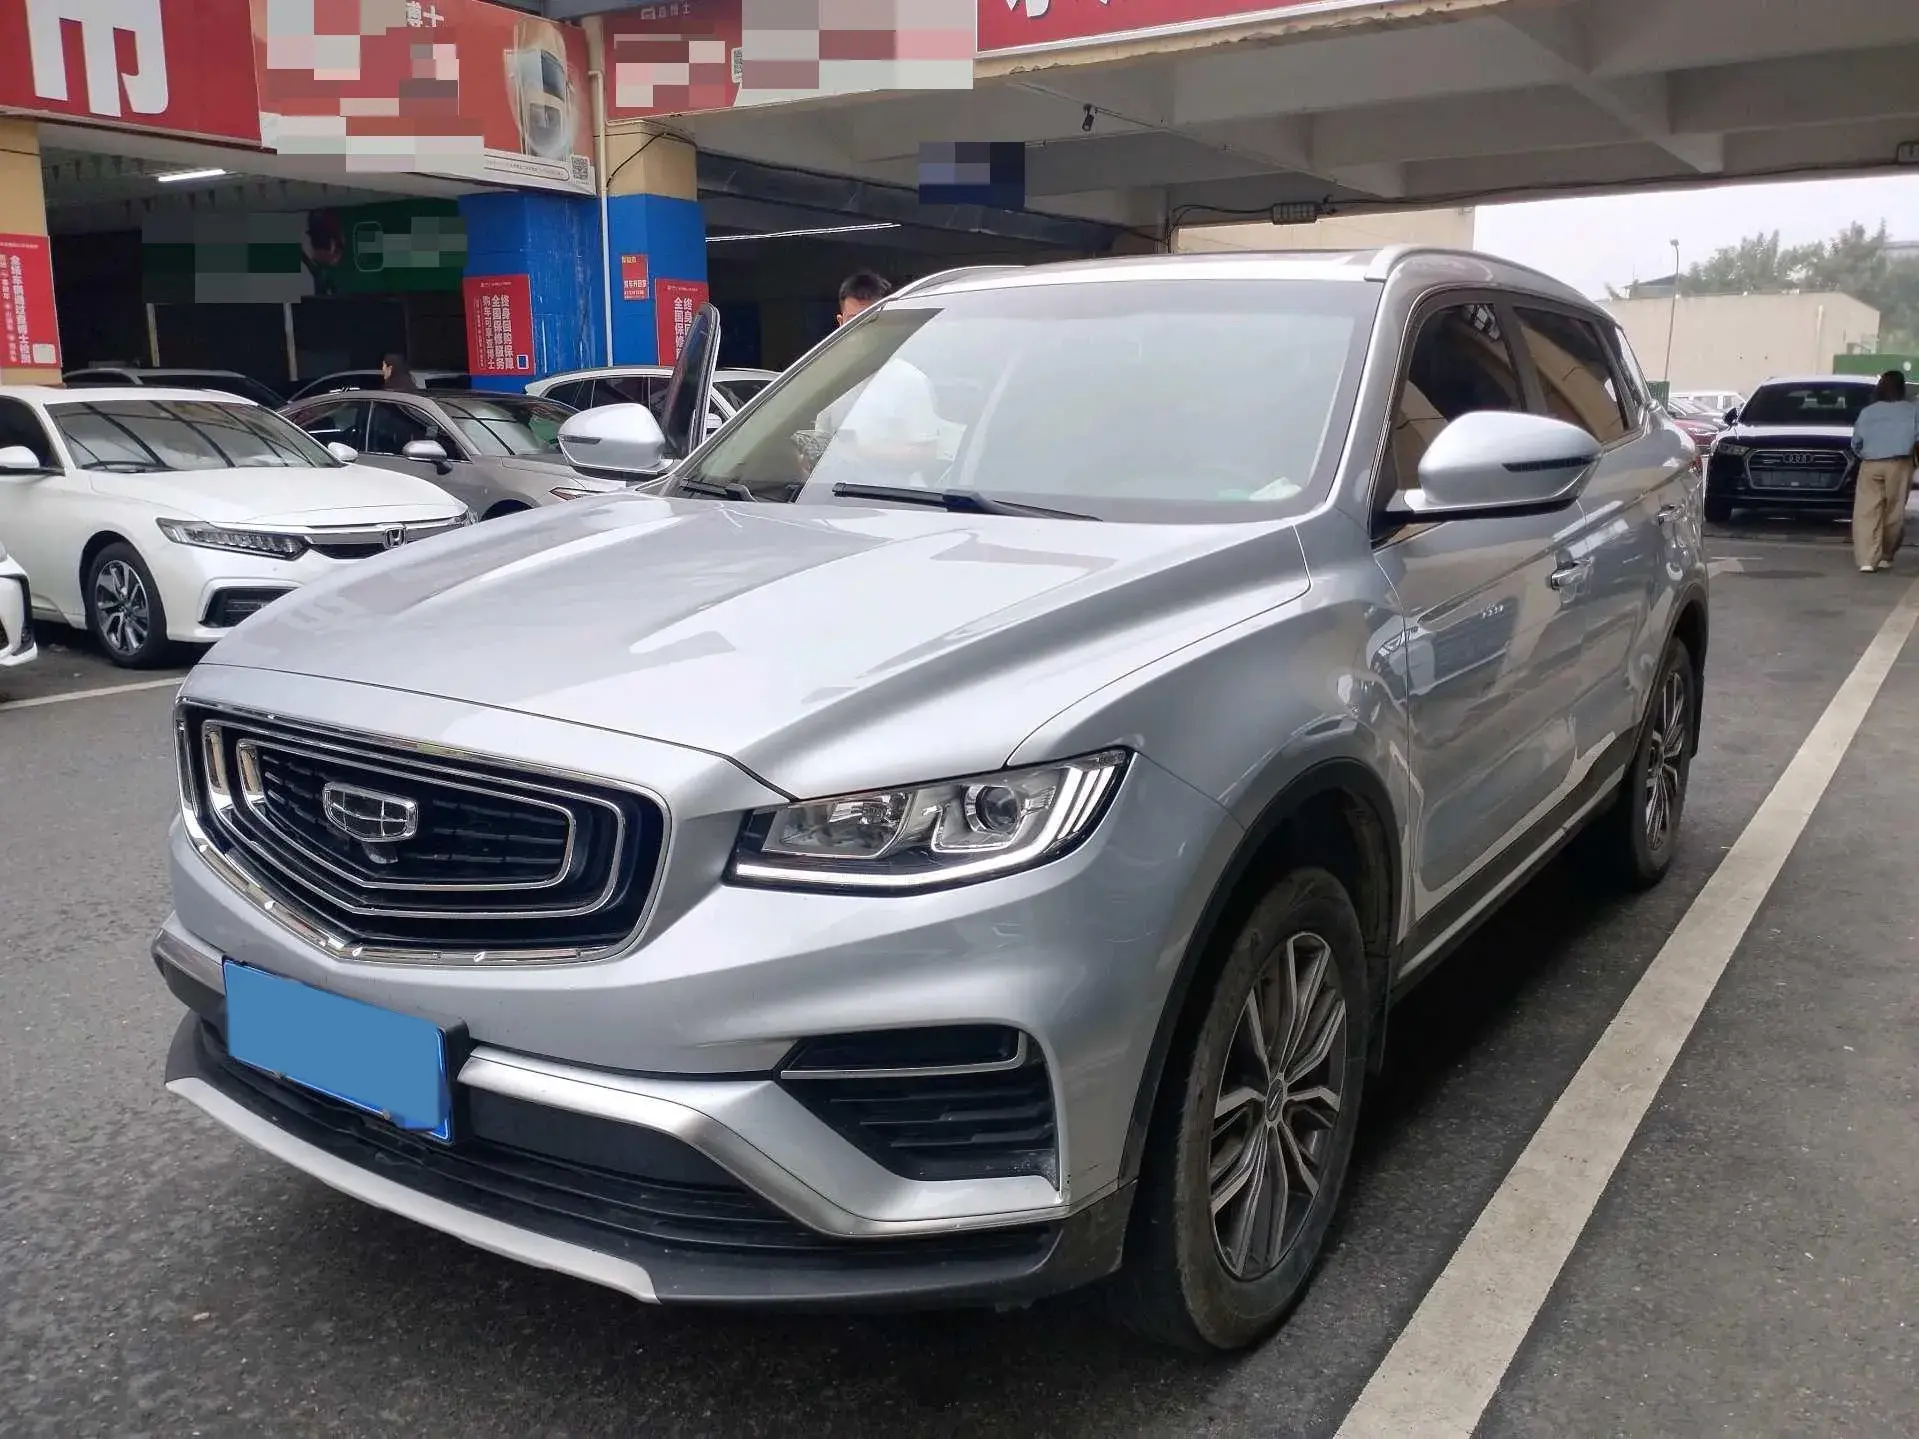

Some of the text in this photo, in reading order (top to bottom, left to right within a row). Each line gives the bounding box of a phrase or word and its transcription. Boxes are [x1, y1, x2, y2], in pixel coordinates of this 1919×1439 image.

[491, 294, 505, 370] 全国保修服务
[500, 295, 514, 369] 终身回购保障
